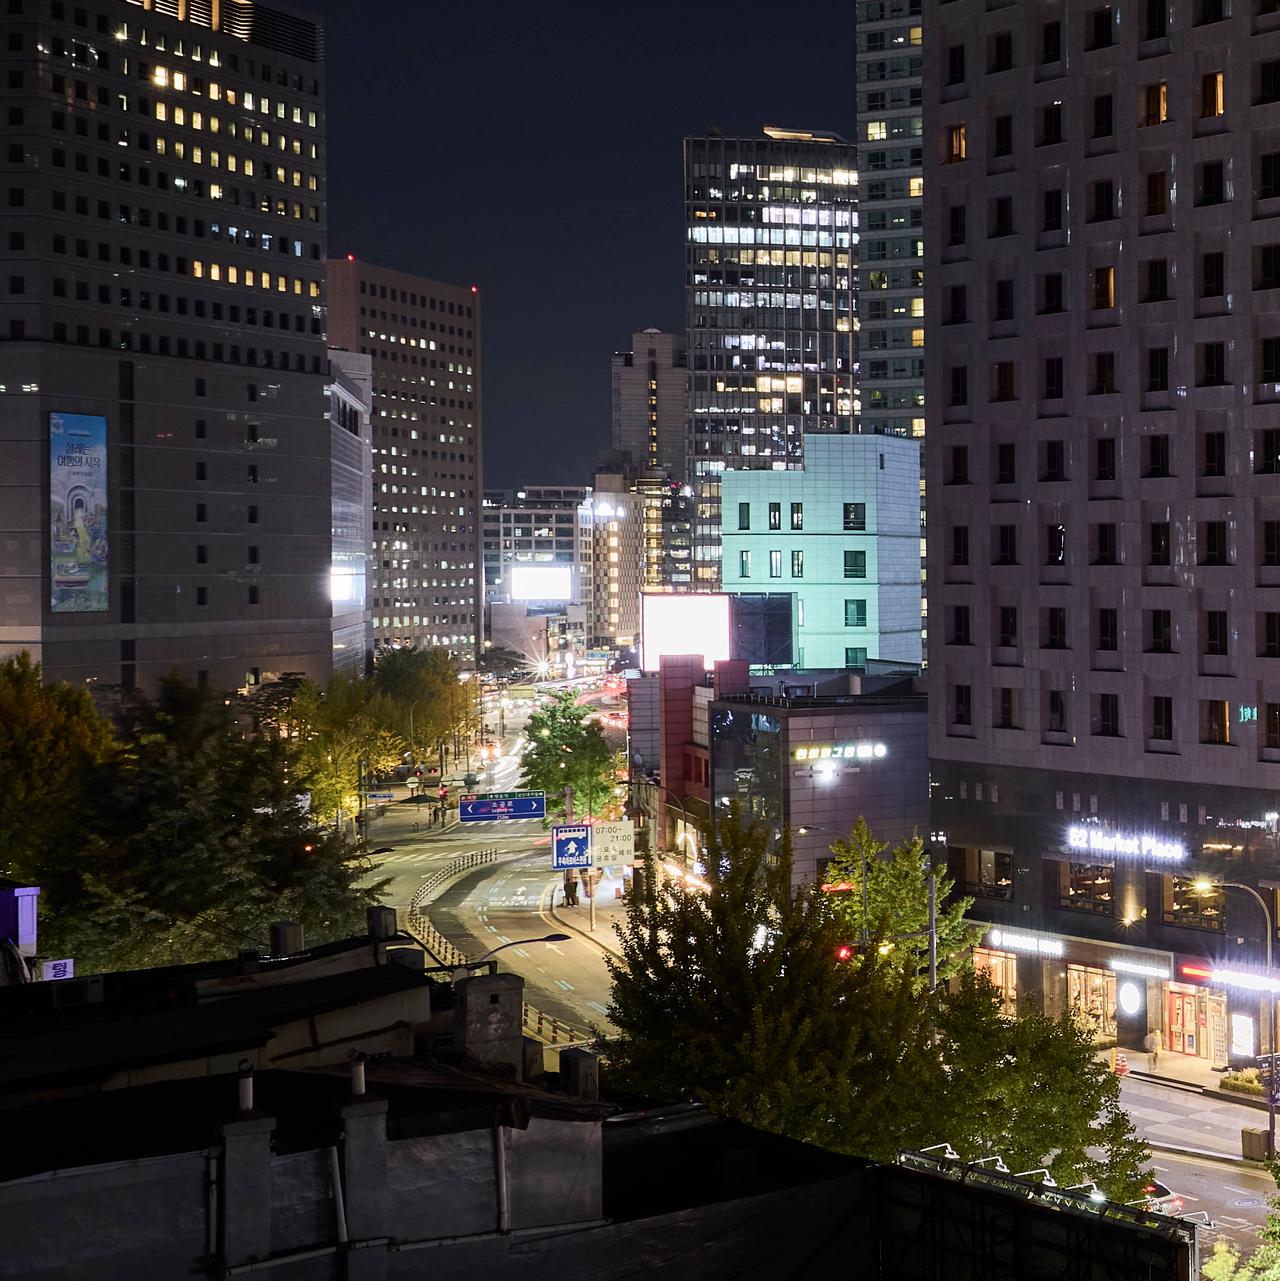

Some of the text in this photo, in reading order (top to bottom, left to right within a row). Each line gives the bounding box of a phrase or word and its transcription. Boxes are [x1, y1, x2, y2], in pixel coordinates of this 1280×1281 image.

[57, 454, 100, 468] 여행의 시작
[610, 834, 632, 843] 21:00
